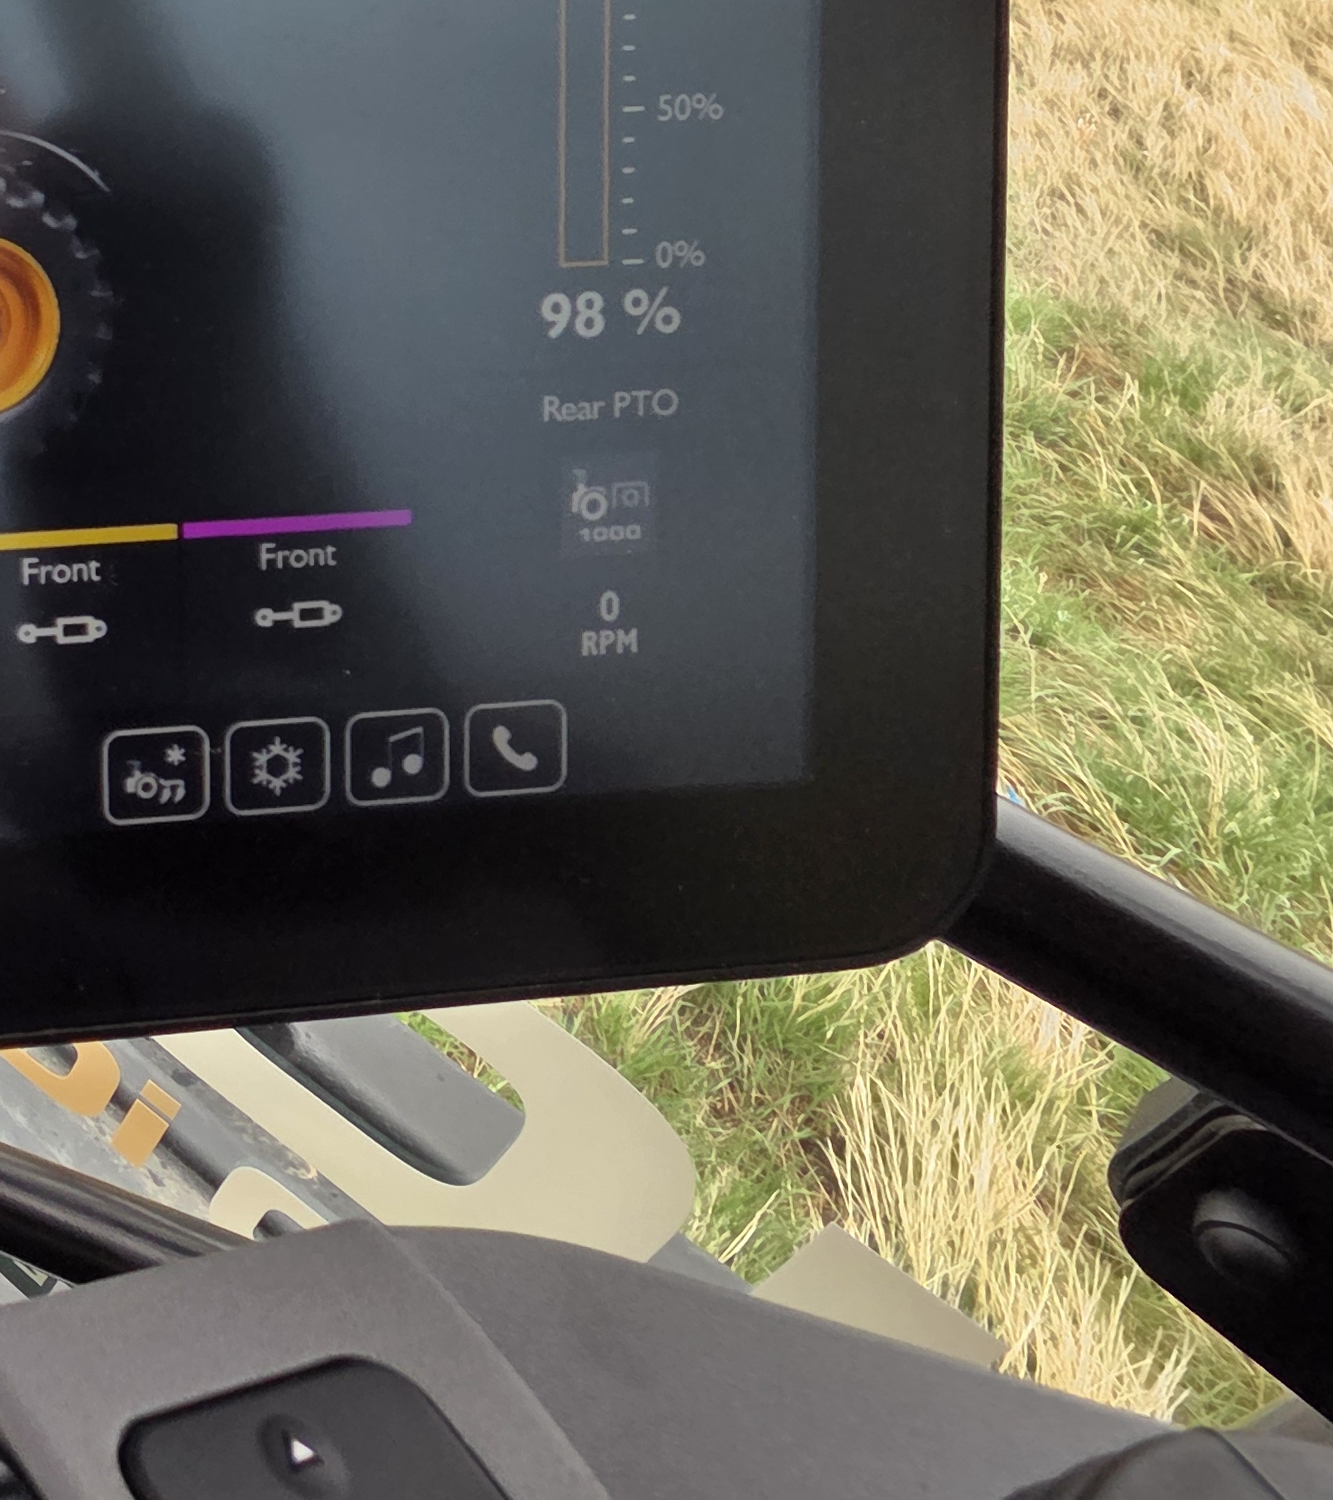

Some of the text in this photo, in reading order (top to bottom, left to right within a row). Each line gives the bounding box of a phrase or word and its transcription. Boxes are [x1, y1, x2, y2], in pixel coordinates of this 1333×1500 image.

[657, 92, 723, 122] 50%
[655, 241, 706, 270] 0%
[541, 286, 681, 340] 98 %
[542, 388, 678, 423] Rear PTO
[580, 524, 642, 542] 1000
[21, 557, 101, 587] Front
[259, 542, 337, 572] Front
[599, 590, 619, 623] 0
[581, 629, 639, 658] RPM
